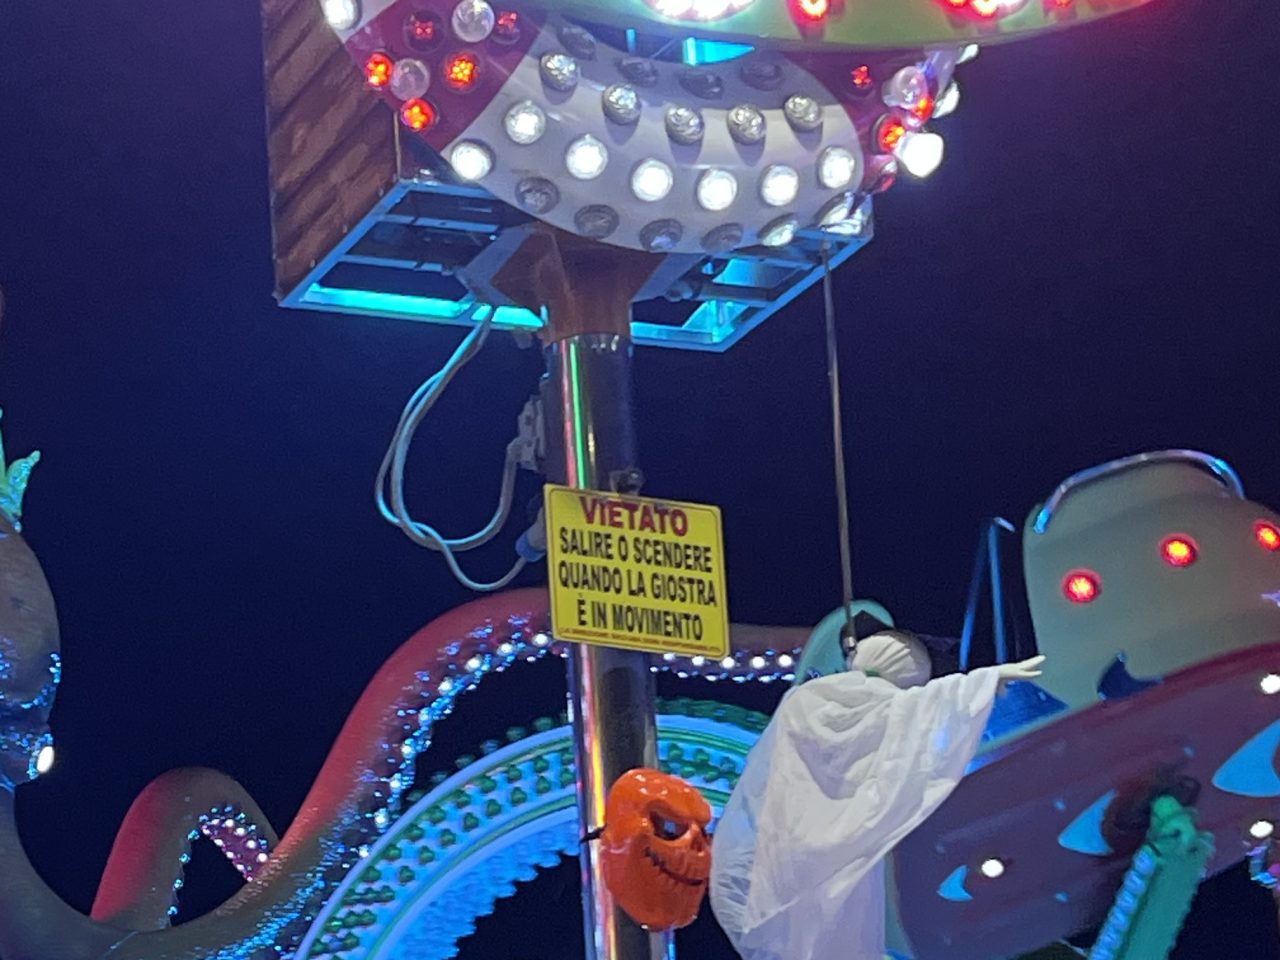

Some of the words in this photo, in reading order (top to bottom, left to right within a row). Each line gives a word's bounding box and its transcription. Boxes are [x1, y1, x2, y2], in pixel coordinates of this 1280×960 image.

[579, 496, 688, 537] VIETATO
[559, 526, 614, 561] SALIRE
[619, 535, 629, 562] O
[633, 537, 713, 573] SCENDERE
[559, 560, 623, 595] QUANDO
[626, 569, 647, 598] LA
[651, 573, 718, 607] GIOSTRA
[592, 601, 608, 629] IN
[612, 604, 704, 641] MOVIMENTO
